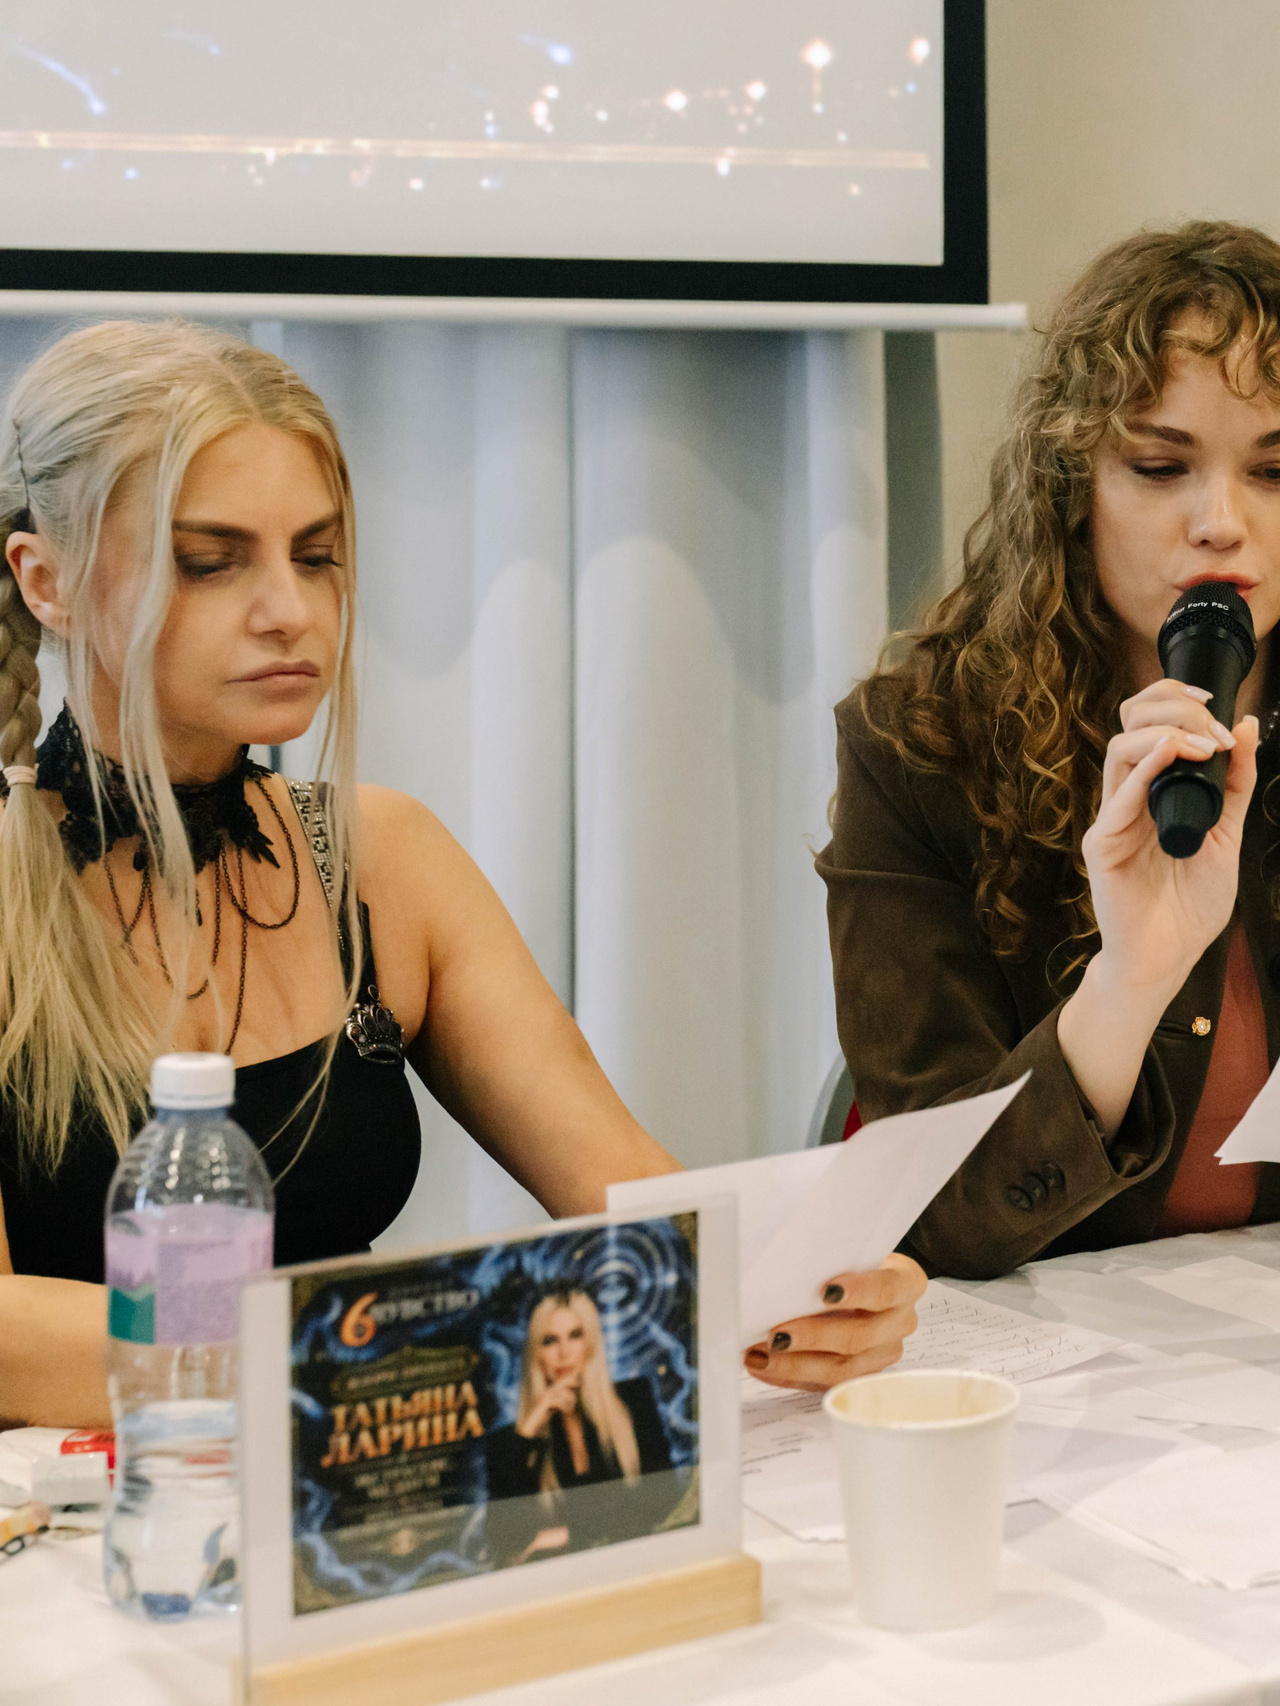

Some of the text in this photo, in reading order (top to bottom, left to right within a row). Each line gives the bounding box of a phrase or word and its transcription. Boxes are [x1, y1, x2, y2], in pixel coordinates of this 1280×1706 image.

[1166, 601, 1229, 623] Arthur Forty PSC
[340, 1291, 379, 1347] 6
